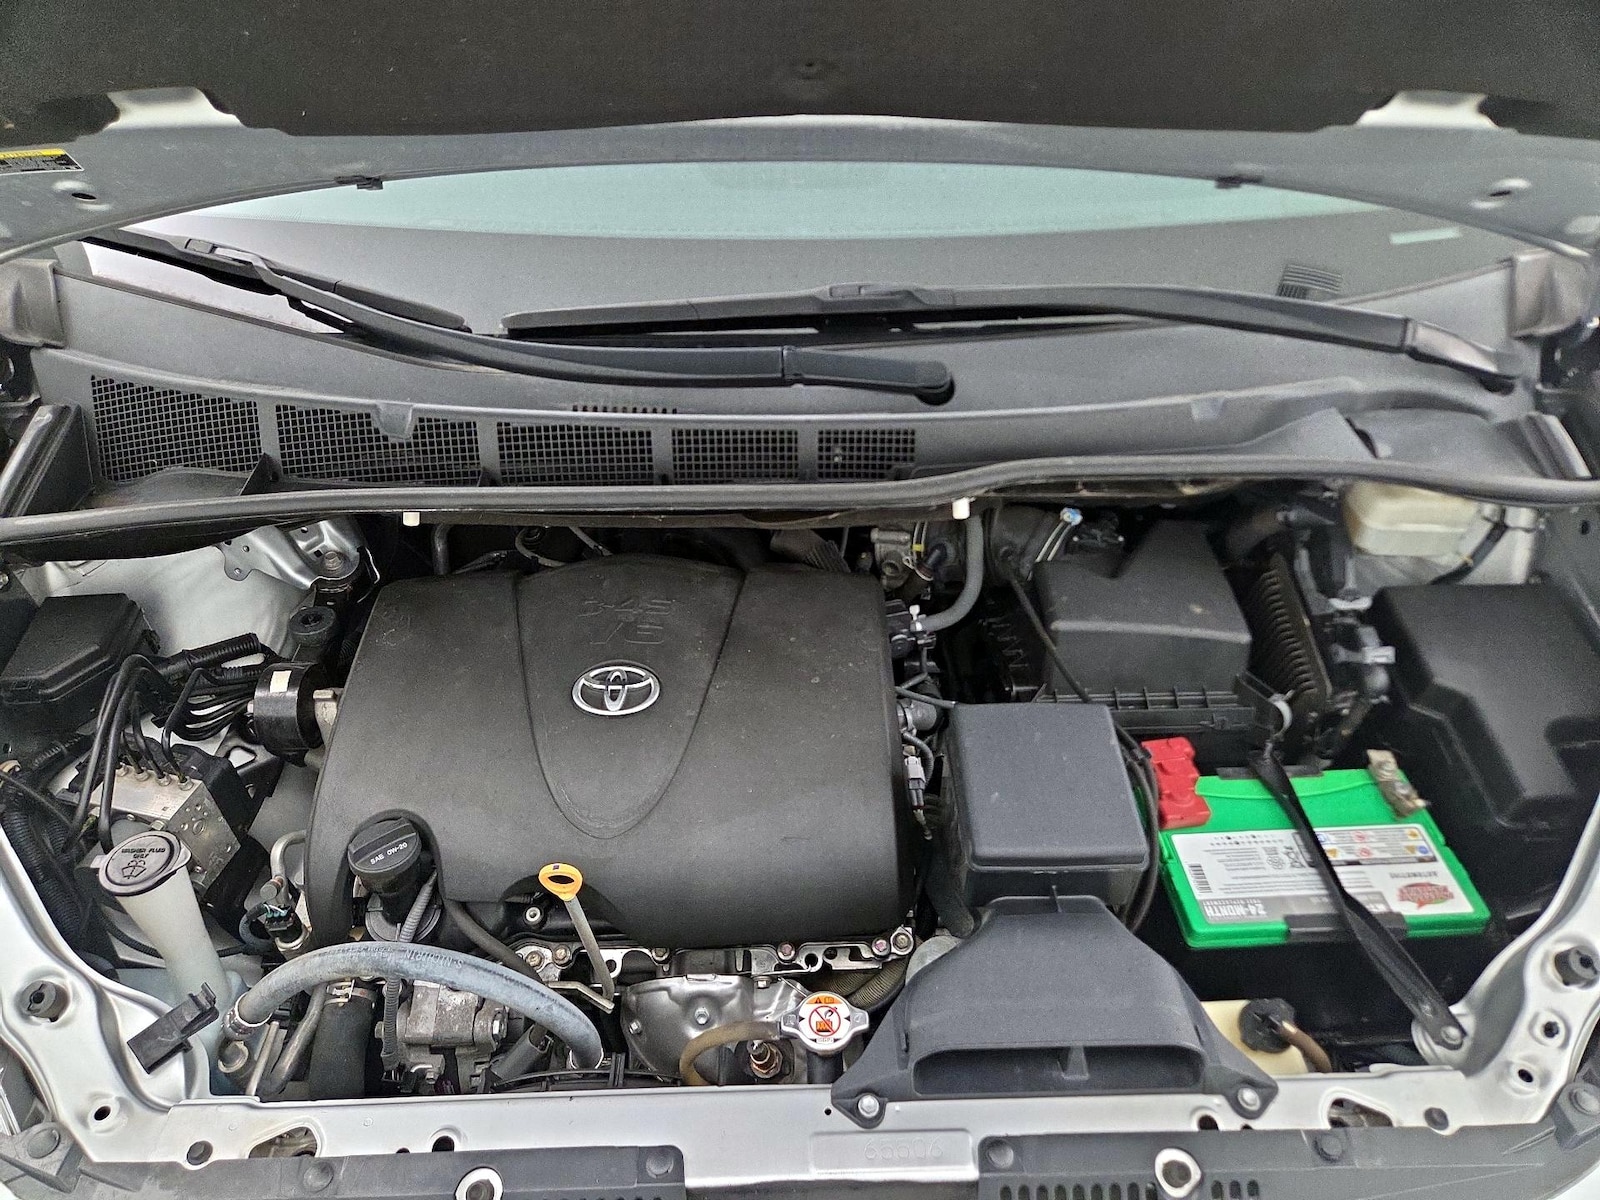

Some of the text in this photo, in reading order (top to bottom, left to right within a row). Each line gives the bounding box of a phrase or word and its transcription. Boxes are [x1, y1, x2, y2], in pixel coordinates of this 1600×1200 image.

[370, 842, 408, 864] SAE 0W-20
[1204, 903, 1267, 917] 24-MONTH
